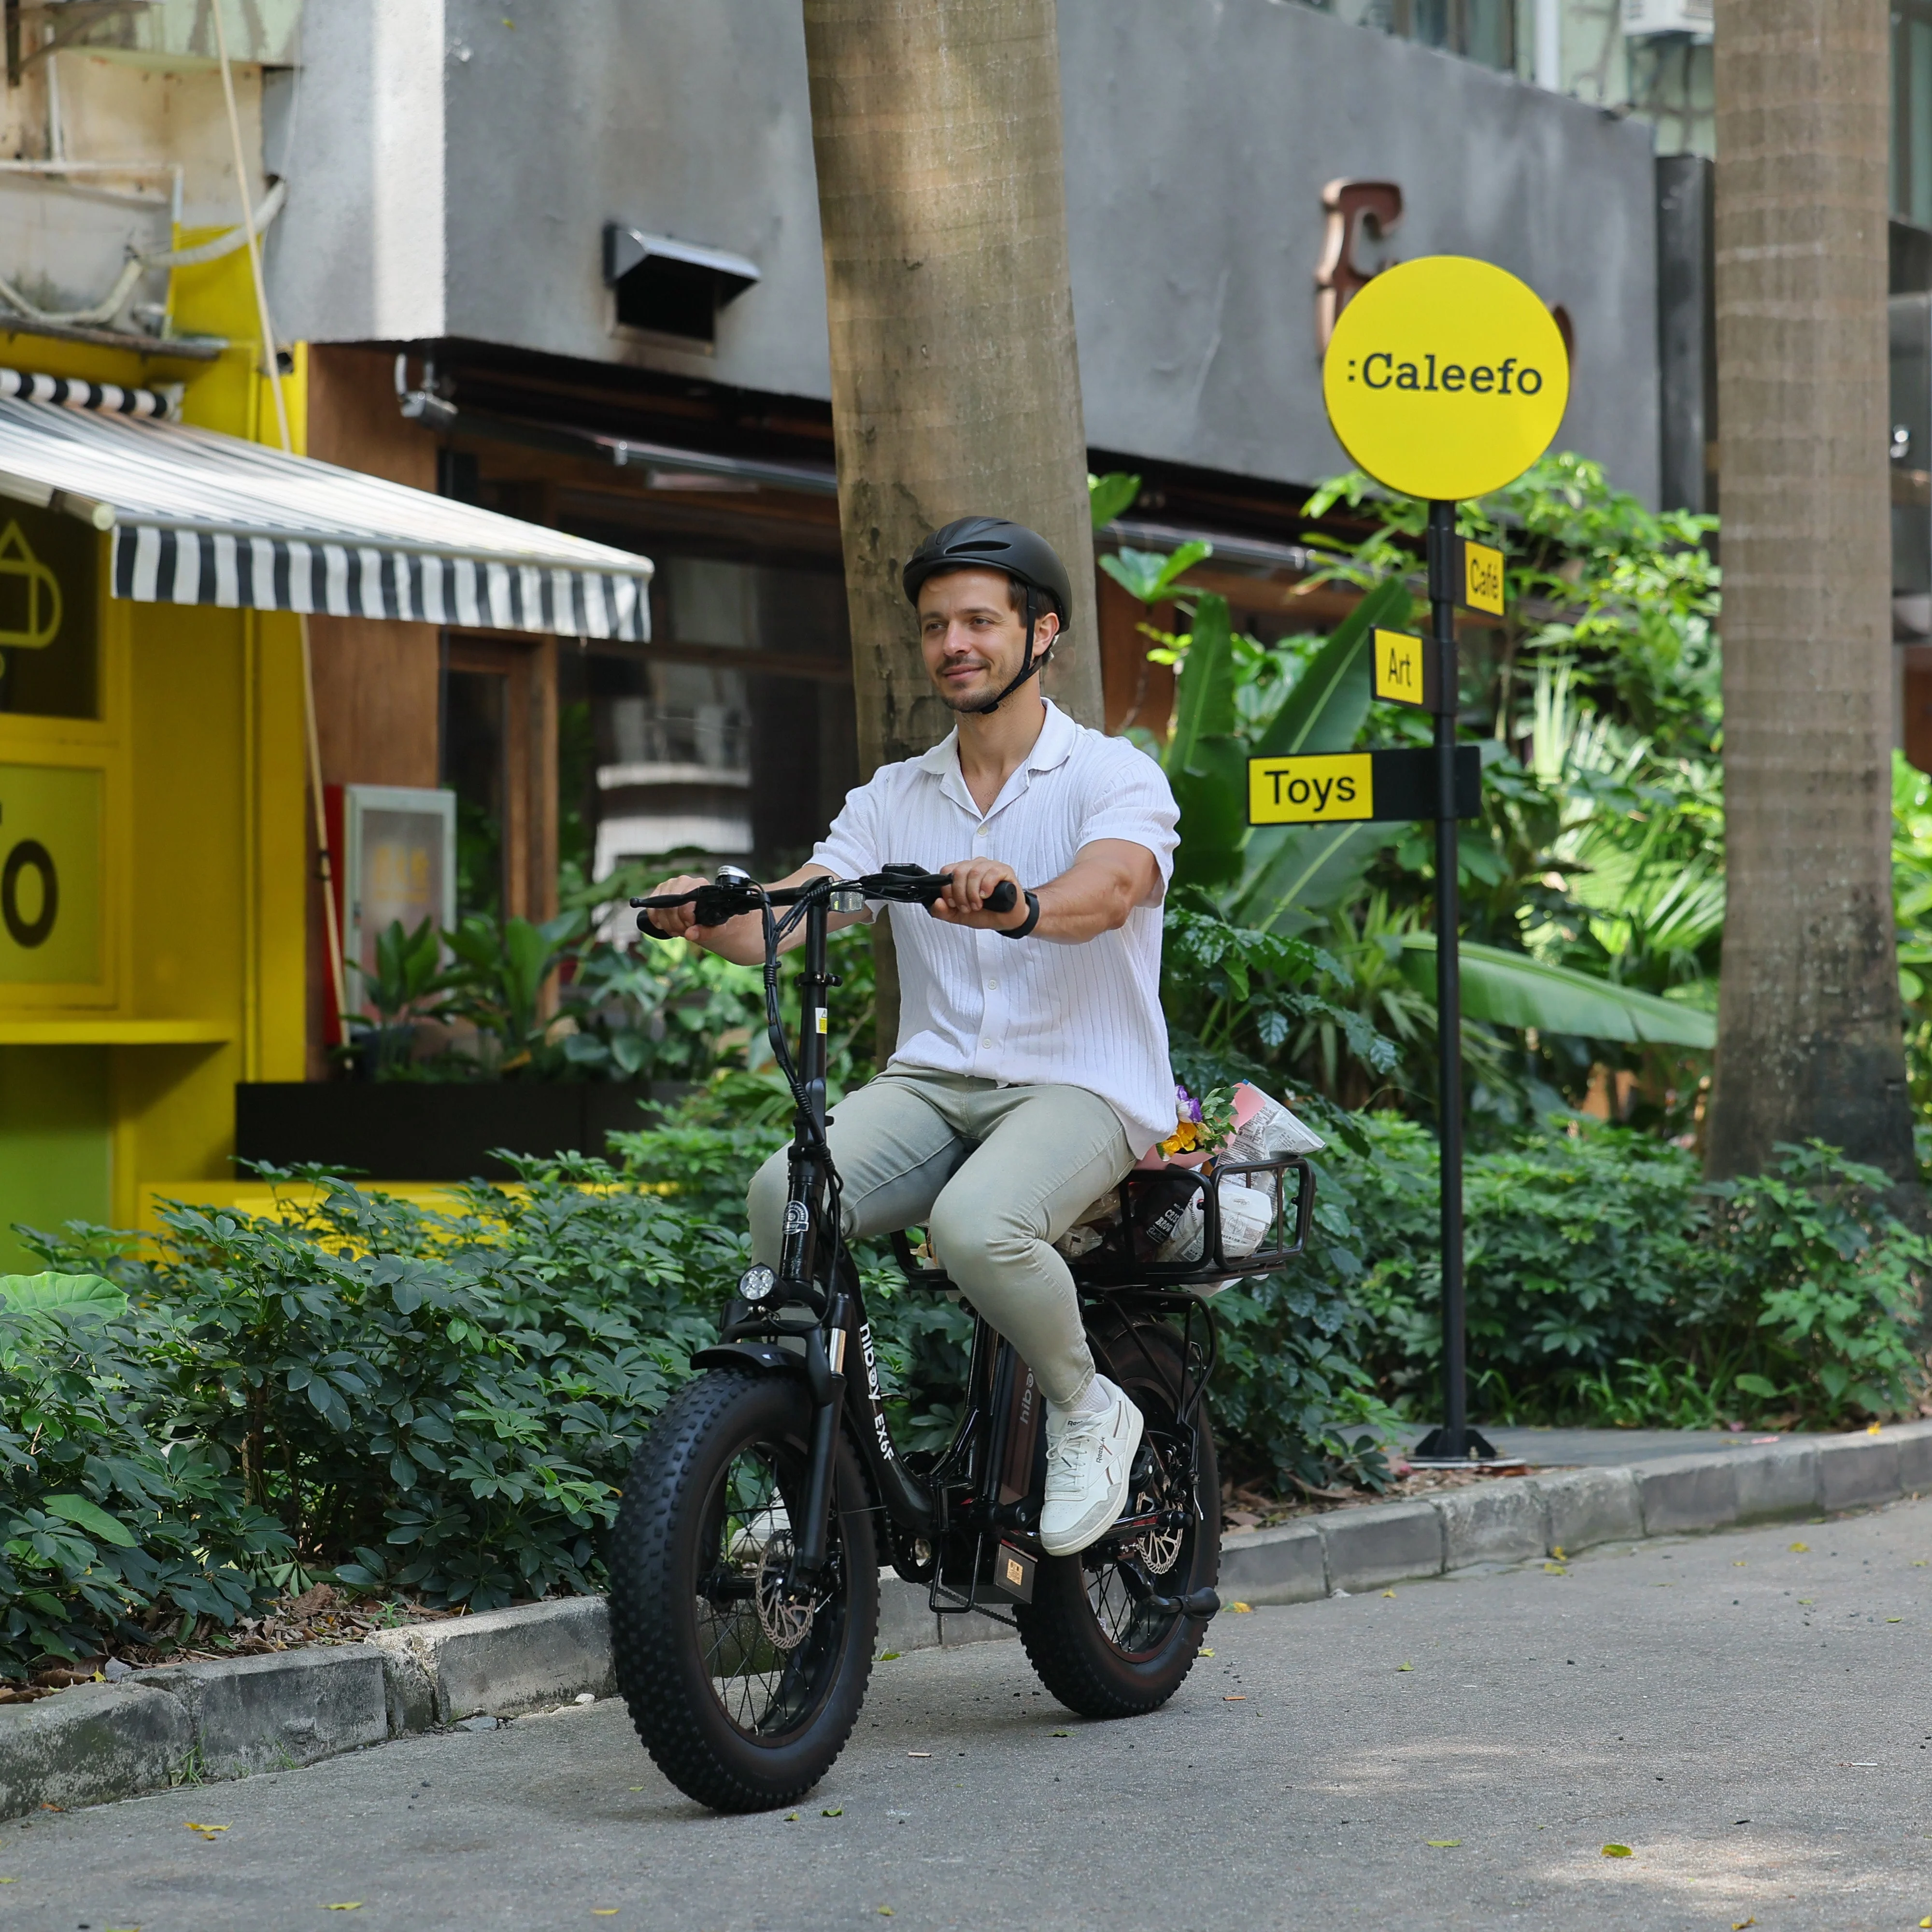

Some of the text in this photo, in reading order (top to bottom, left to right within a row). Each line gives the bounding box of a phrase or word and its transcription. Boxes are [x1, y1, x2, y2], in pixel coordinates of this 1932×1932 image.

[1349, 353, 1543, 395] :Caleefo
[1470, 558, 1498, 599] Café
[1388, 647, 1411, 688] Art
[1264, 770, 1356, 812] Toys
[874, 1413, 895, 1461] EX6F
[1096, 1436, 1106, 1463] Reebk
